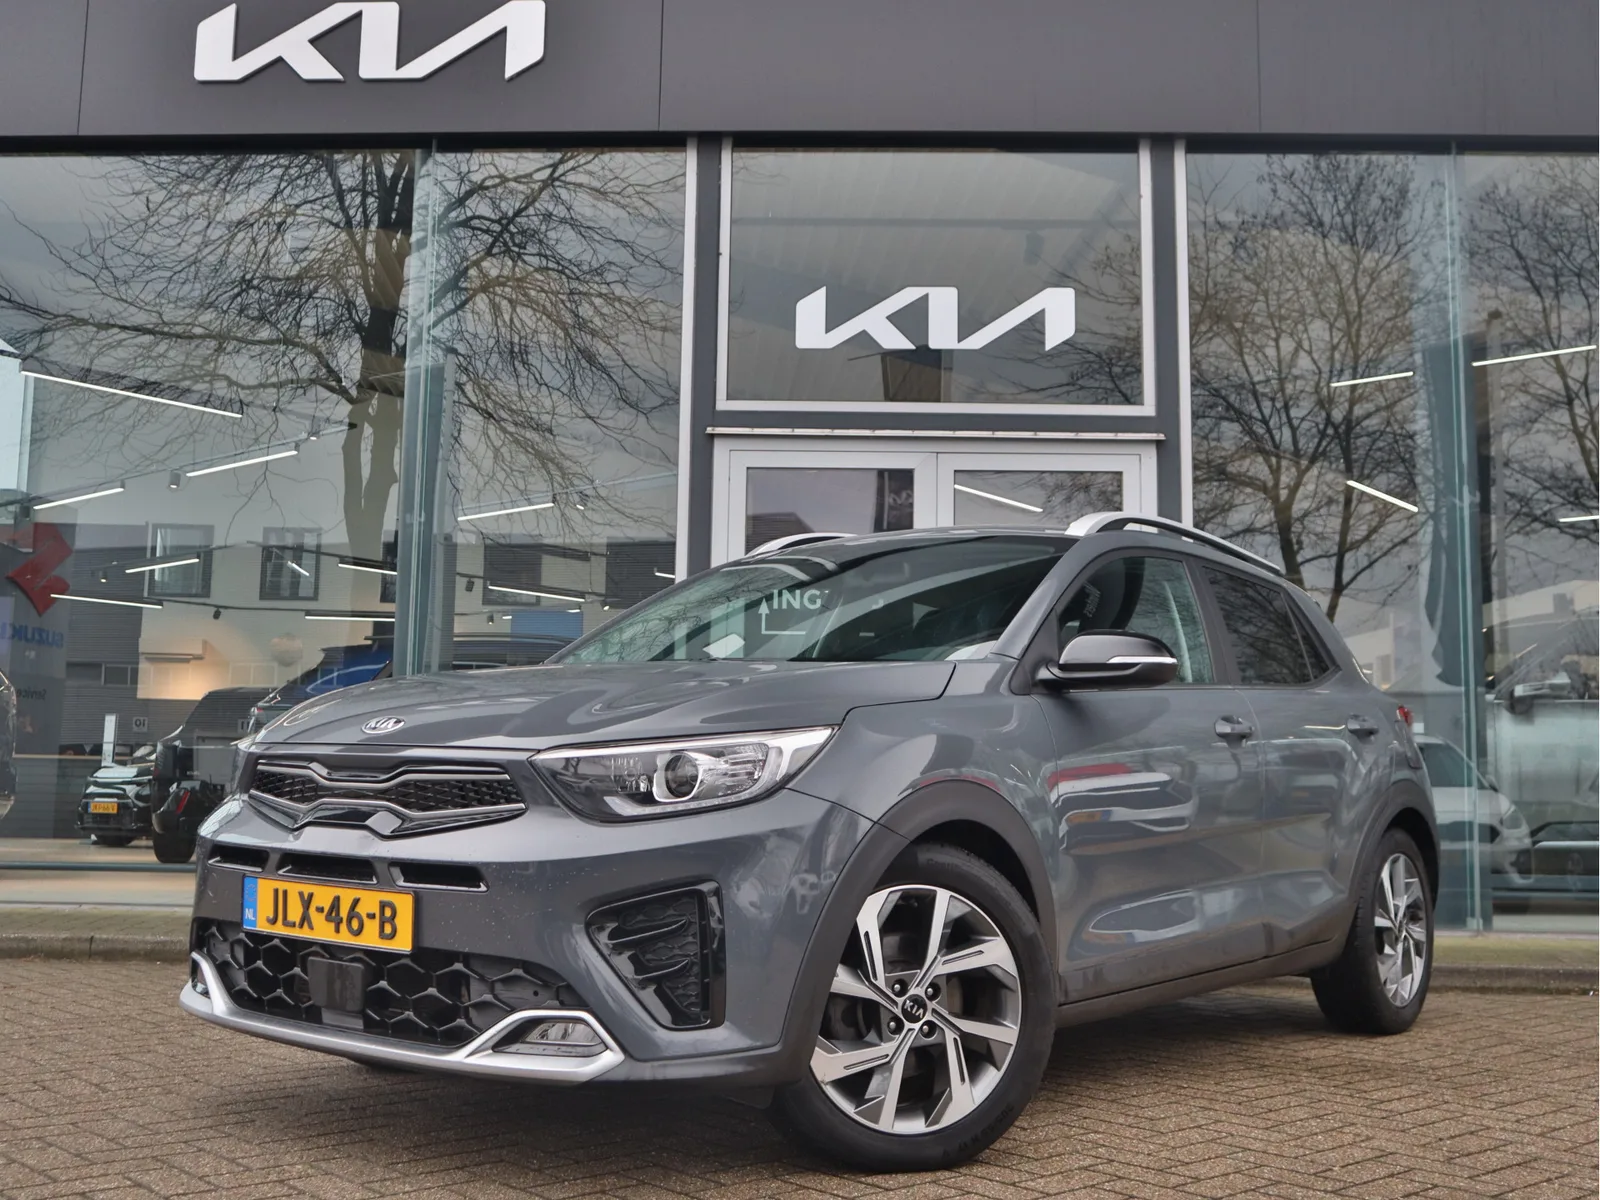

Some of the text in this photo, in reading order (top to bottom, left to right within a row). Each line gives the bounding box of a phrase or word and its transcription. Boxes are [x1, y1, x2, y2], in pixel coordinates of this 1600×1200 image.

[194, 0, 546, 82] KIA
[795, 286, 1076, 351] KIA
[364, 716, 401, 731] KIA
[245, 907, 256, 921] NL
[266, 887, 398, 941] JLX-46-B
[904, 1000, 925, 1019] KIA
